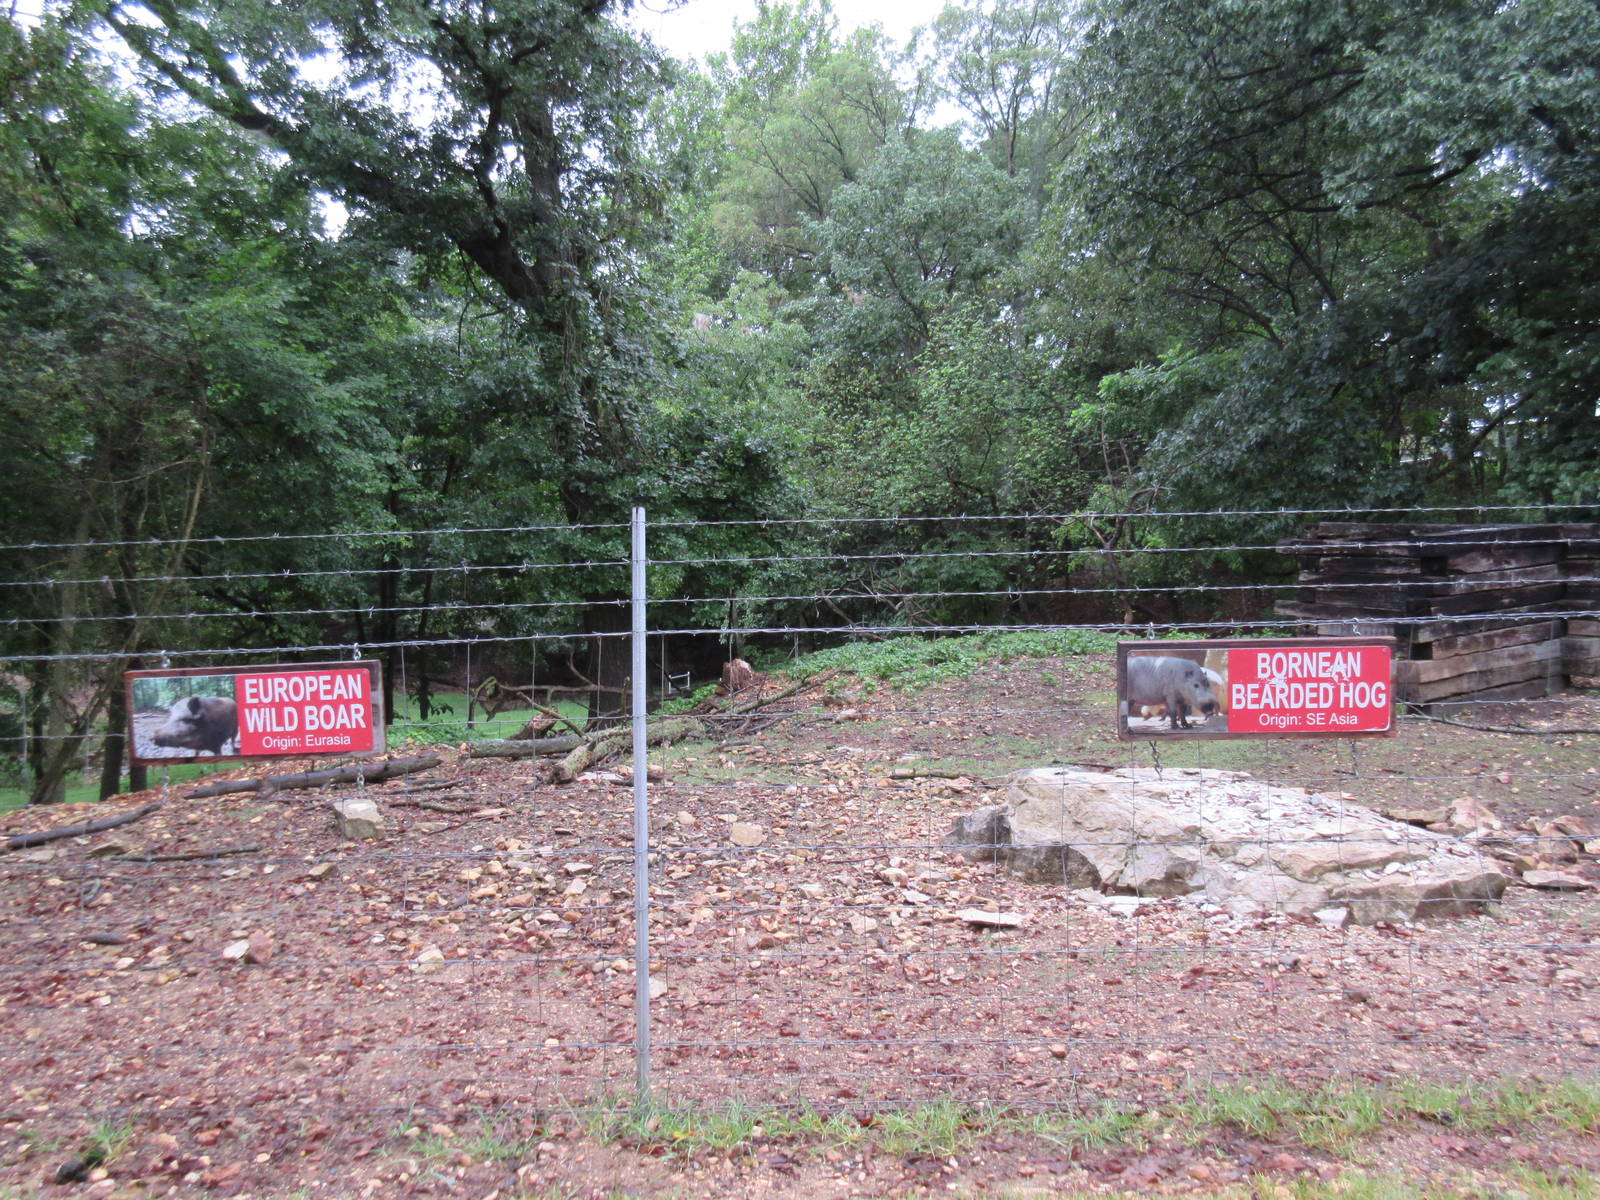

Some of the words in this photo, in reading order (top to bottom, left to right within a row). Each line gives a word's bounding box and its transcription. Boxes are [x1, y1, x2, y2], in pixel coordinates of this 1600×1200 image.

[1257, 652, 1361, 679] BORNEAN
[245, 675, 362, 704] EUROPEAN
[1232, 683, 1333, 709] BEARDED
[1340, 682, 1386, 709] HOG
[245, 707, 298, 732] WILD
[304, 703, 366, 730] BOAR
[1258, 713, 1302, 728] Origin:
[1306, 713, 1326, 725] SE
[1328, 712, 1358, 725] Asia
[262, 735, 301, 750] Origin:
[305, 733, 351, 746] Eurasia
